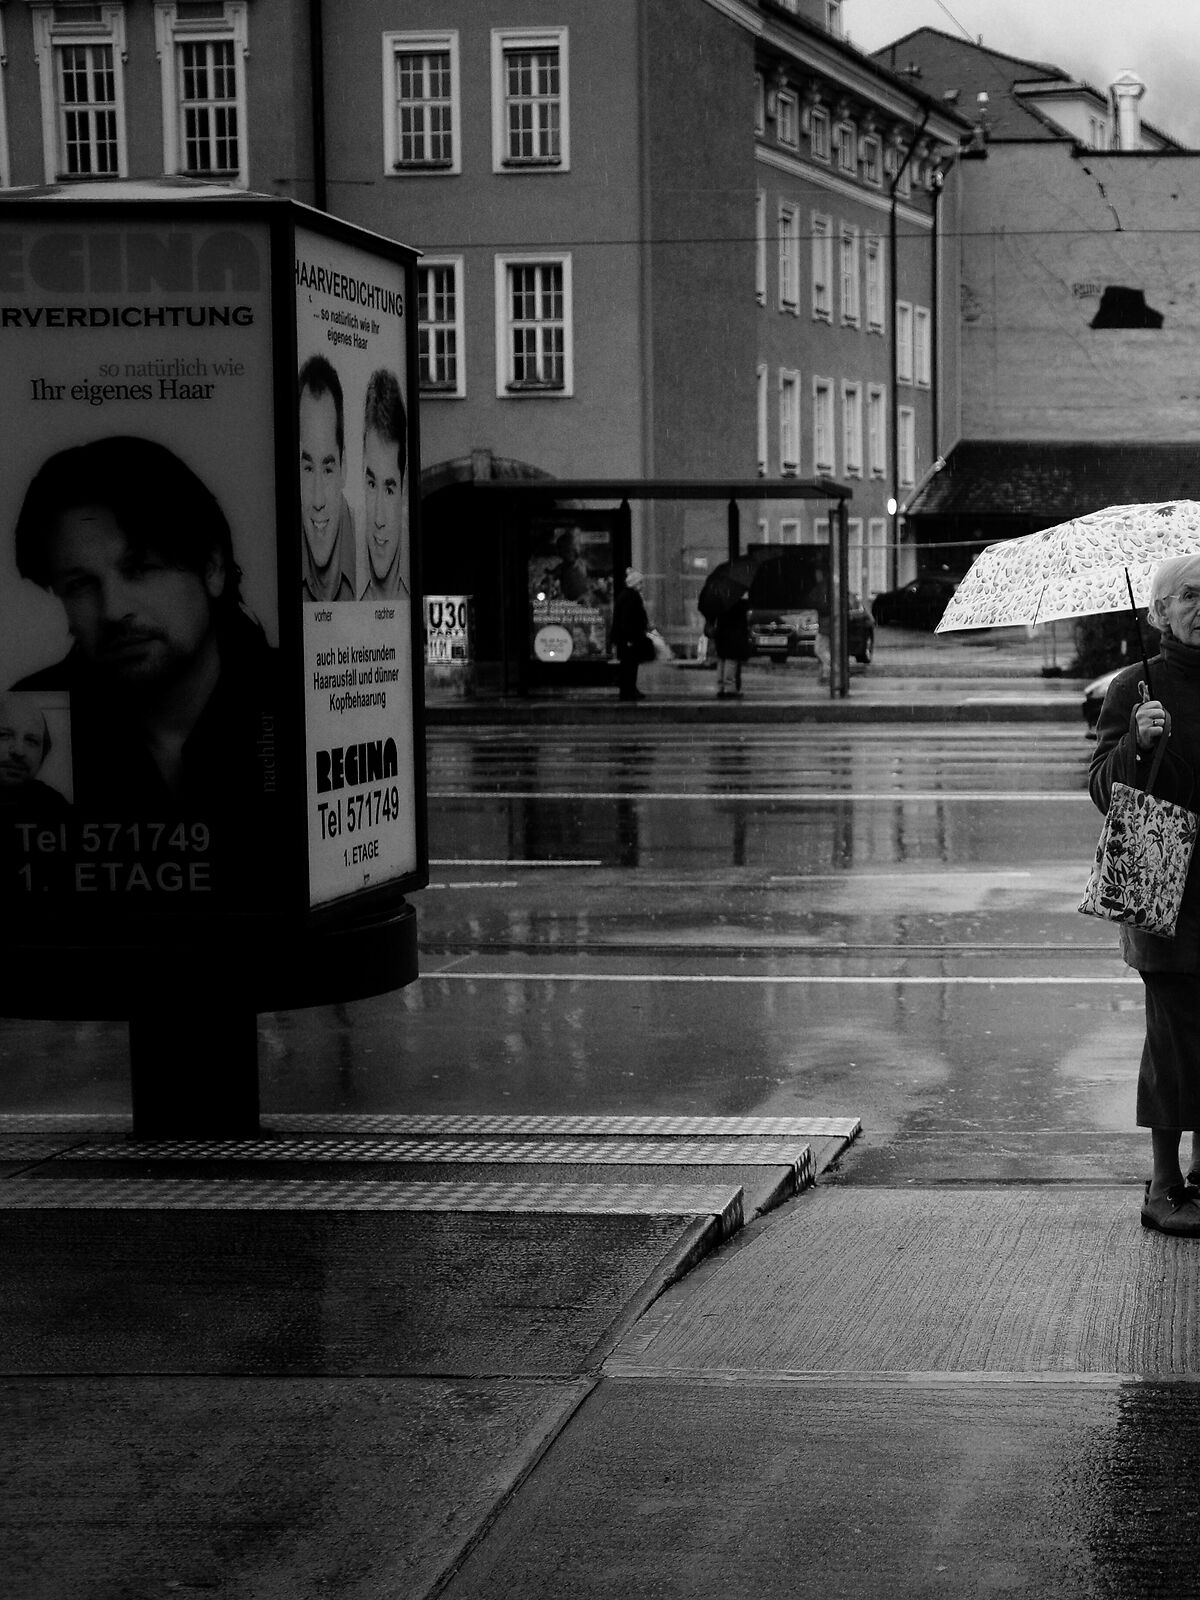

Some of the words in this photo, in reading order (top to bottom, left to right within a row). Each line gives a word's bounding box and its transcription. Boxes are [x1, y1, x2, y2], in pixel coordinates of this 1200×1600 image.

[294, 259, 403, 318] HAARVERDICHTUNG
[320, 308, 330, 321] so
[99, 366, 120, 378] so
[125, 357, 208, 378] natürlich
[213, 358, 245, 377] wie
[31, 378, 66, 401] Ihr
[71, 379, 153, 406] eigenes
[159, 379, 215, 400] Haar
[316, 648, 336, 666] auch
[337, 647, 350, 664] bei
[351, 645, 396, 663] kreisrundem
[313, 669, 357, 690] Haarausfall
[358, 667, 373, 685] und
[374, 666, 399, 683] dünner
[329, 691, 386, 714] Kopfbehaarung
[316, 737, 398, 794] REGINA
[318, 800, 342, 839] Tel
[347, 786, 399, 832] 571749
[14, 823, 67, 852] Tel
[81, 822, 210, 852] 571749
[344, 849, 351, 867] 1.
[352, 840, 379, 864] ETAGE
[18, 863, 49, 892] 1.
[74, 862, 213, 893] ETAGE
